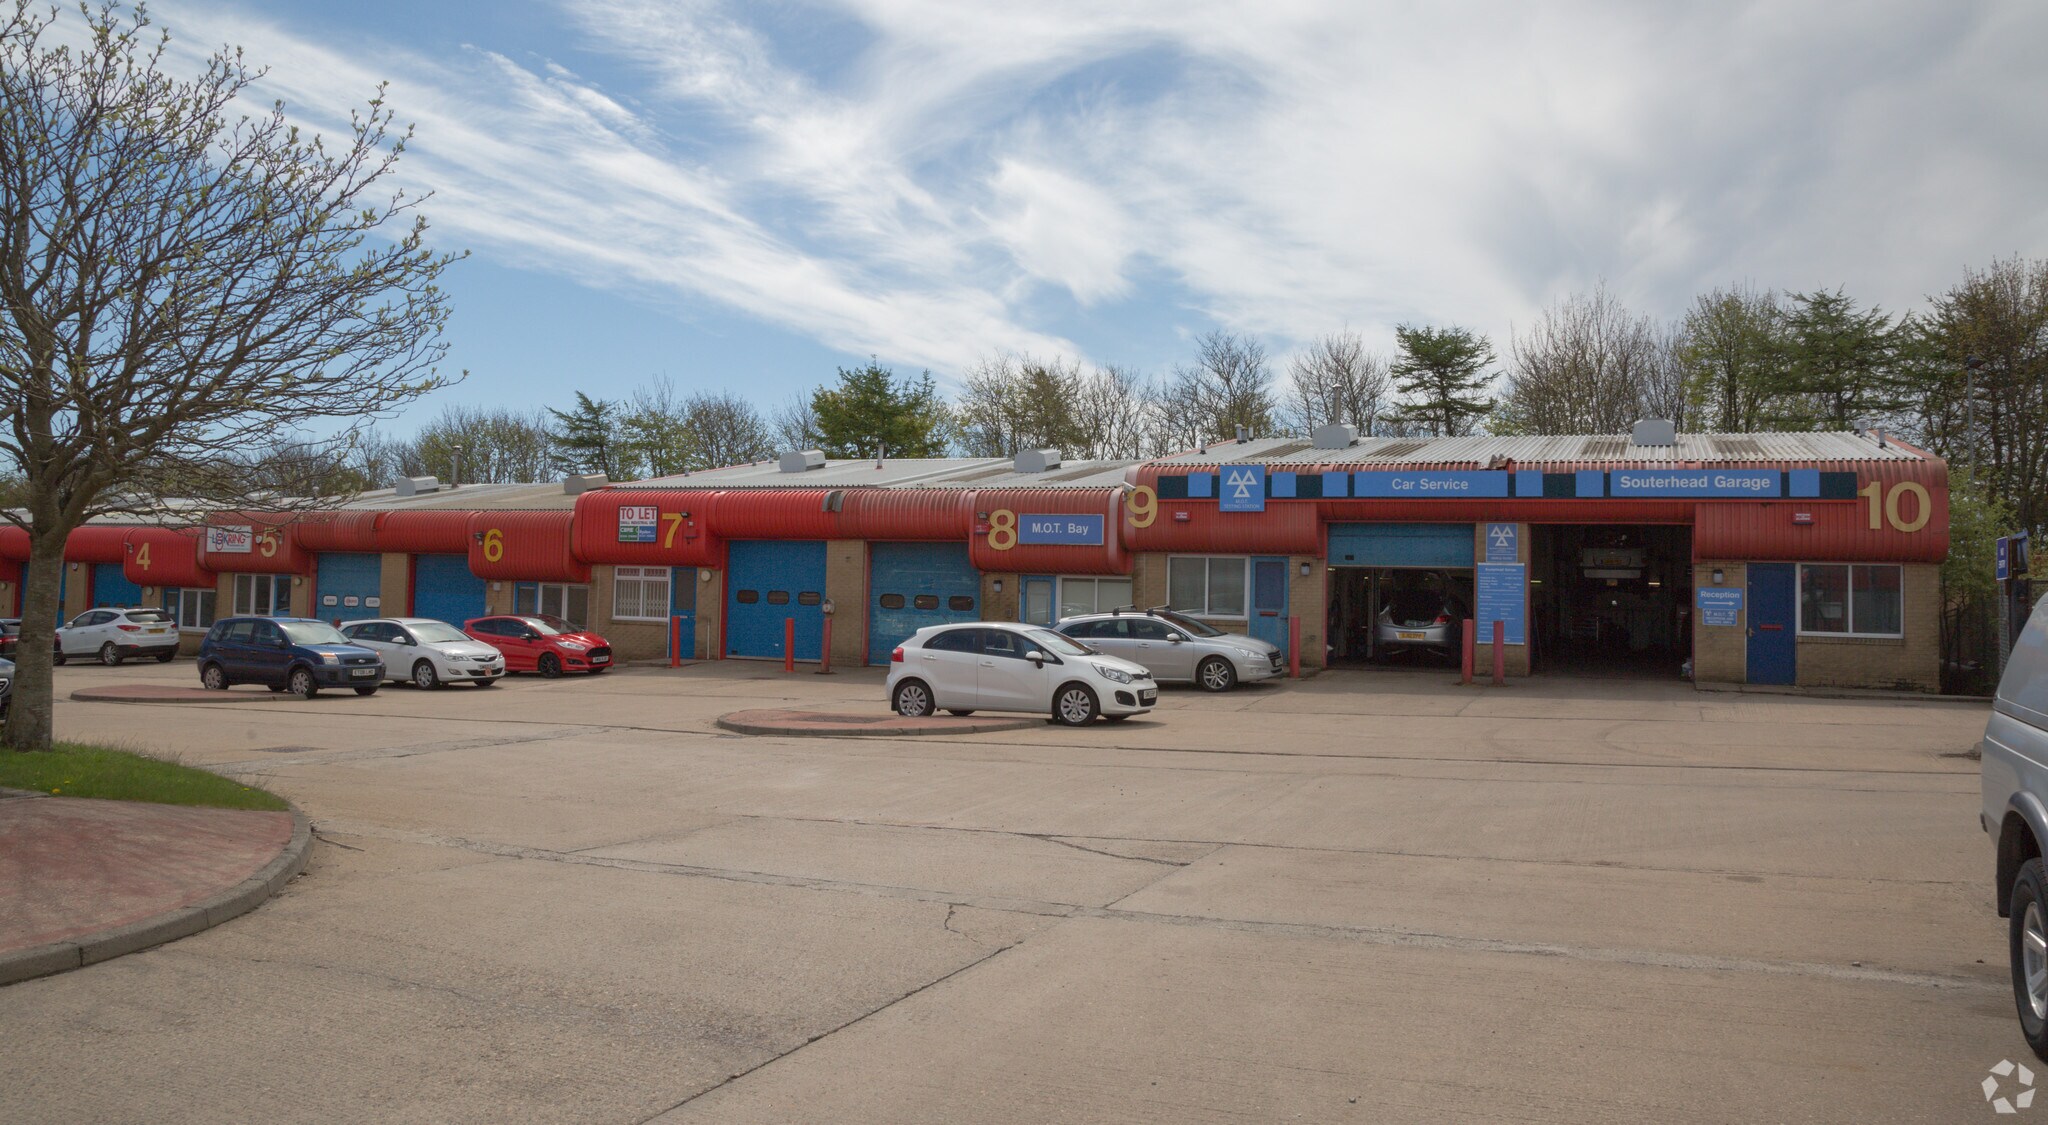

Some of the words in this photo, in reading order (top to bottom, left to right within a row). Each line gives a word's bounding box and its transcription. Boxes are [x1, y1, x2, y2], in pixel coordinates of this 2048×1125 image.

[1392, 478, 1415, 490] Car
[1420, 478, 1469, 490] Service
[1620, 476, 1708, 489] Souterhead
[1714, 476, 1770, 491] Garage
[620, 508, 634, 519] TO
[639, 508, 656, 519] LET
[1127, 485, 1158, 528] 9
[1857, 481, 1932, 533] 10
[260, 527, 277, 557] 5
[662, 513, 683, 548] 7
[987, 509, 1017, 550] 8
[1032, 523, 1062, 533] M.O.T.
[1067, 523, 1089, 535] Bay
[136, 542, 151, 570] 4
[484, 528, 503, 562] 6
[1700, 591, 1740, 599] Reception
